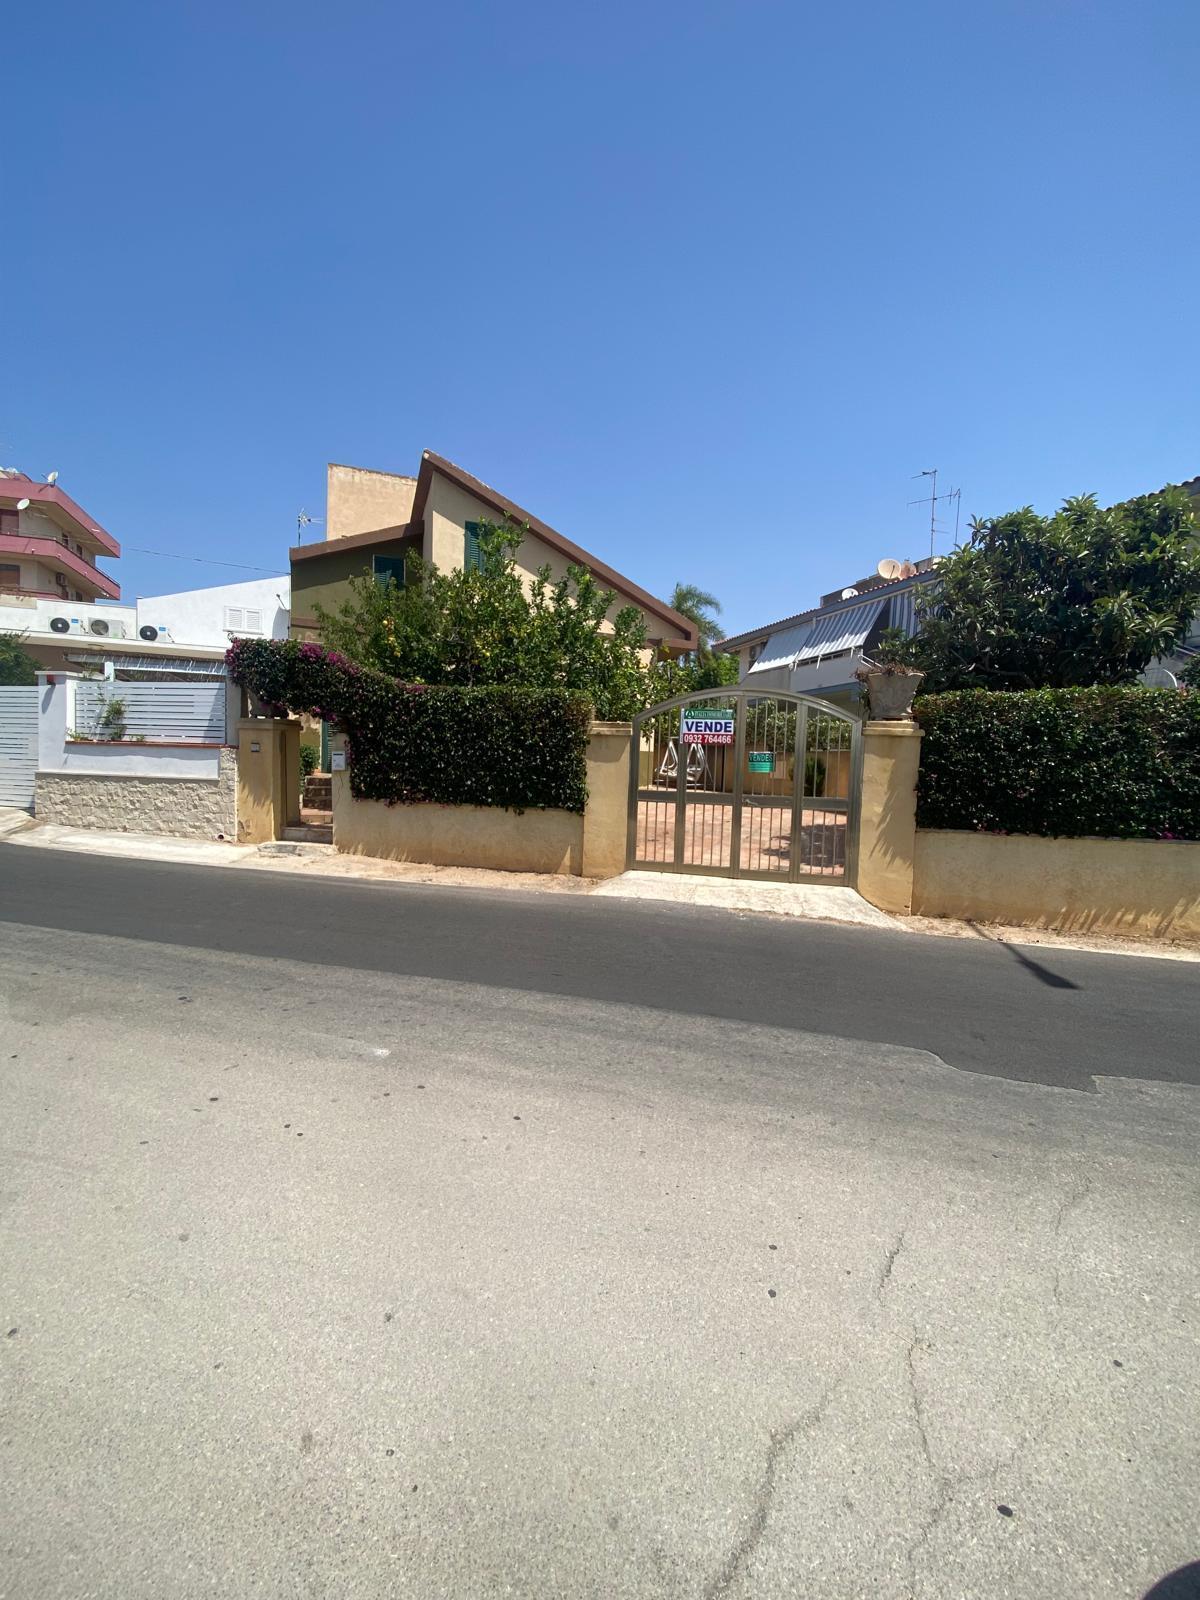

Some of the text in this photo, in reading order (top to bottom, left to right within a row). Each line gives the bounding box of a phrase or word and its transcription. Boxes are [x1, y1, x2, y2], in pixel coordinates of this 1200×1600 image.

[685, 721, 732, 733] VENDE
[684, 735, 732, 744] 0932 764466
[749, 754, 774, 762] VENDES
